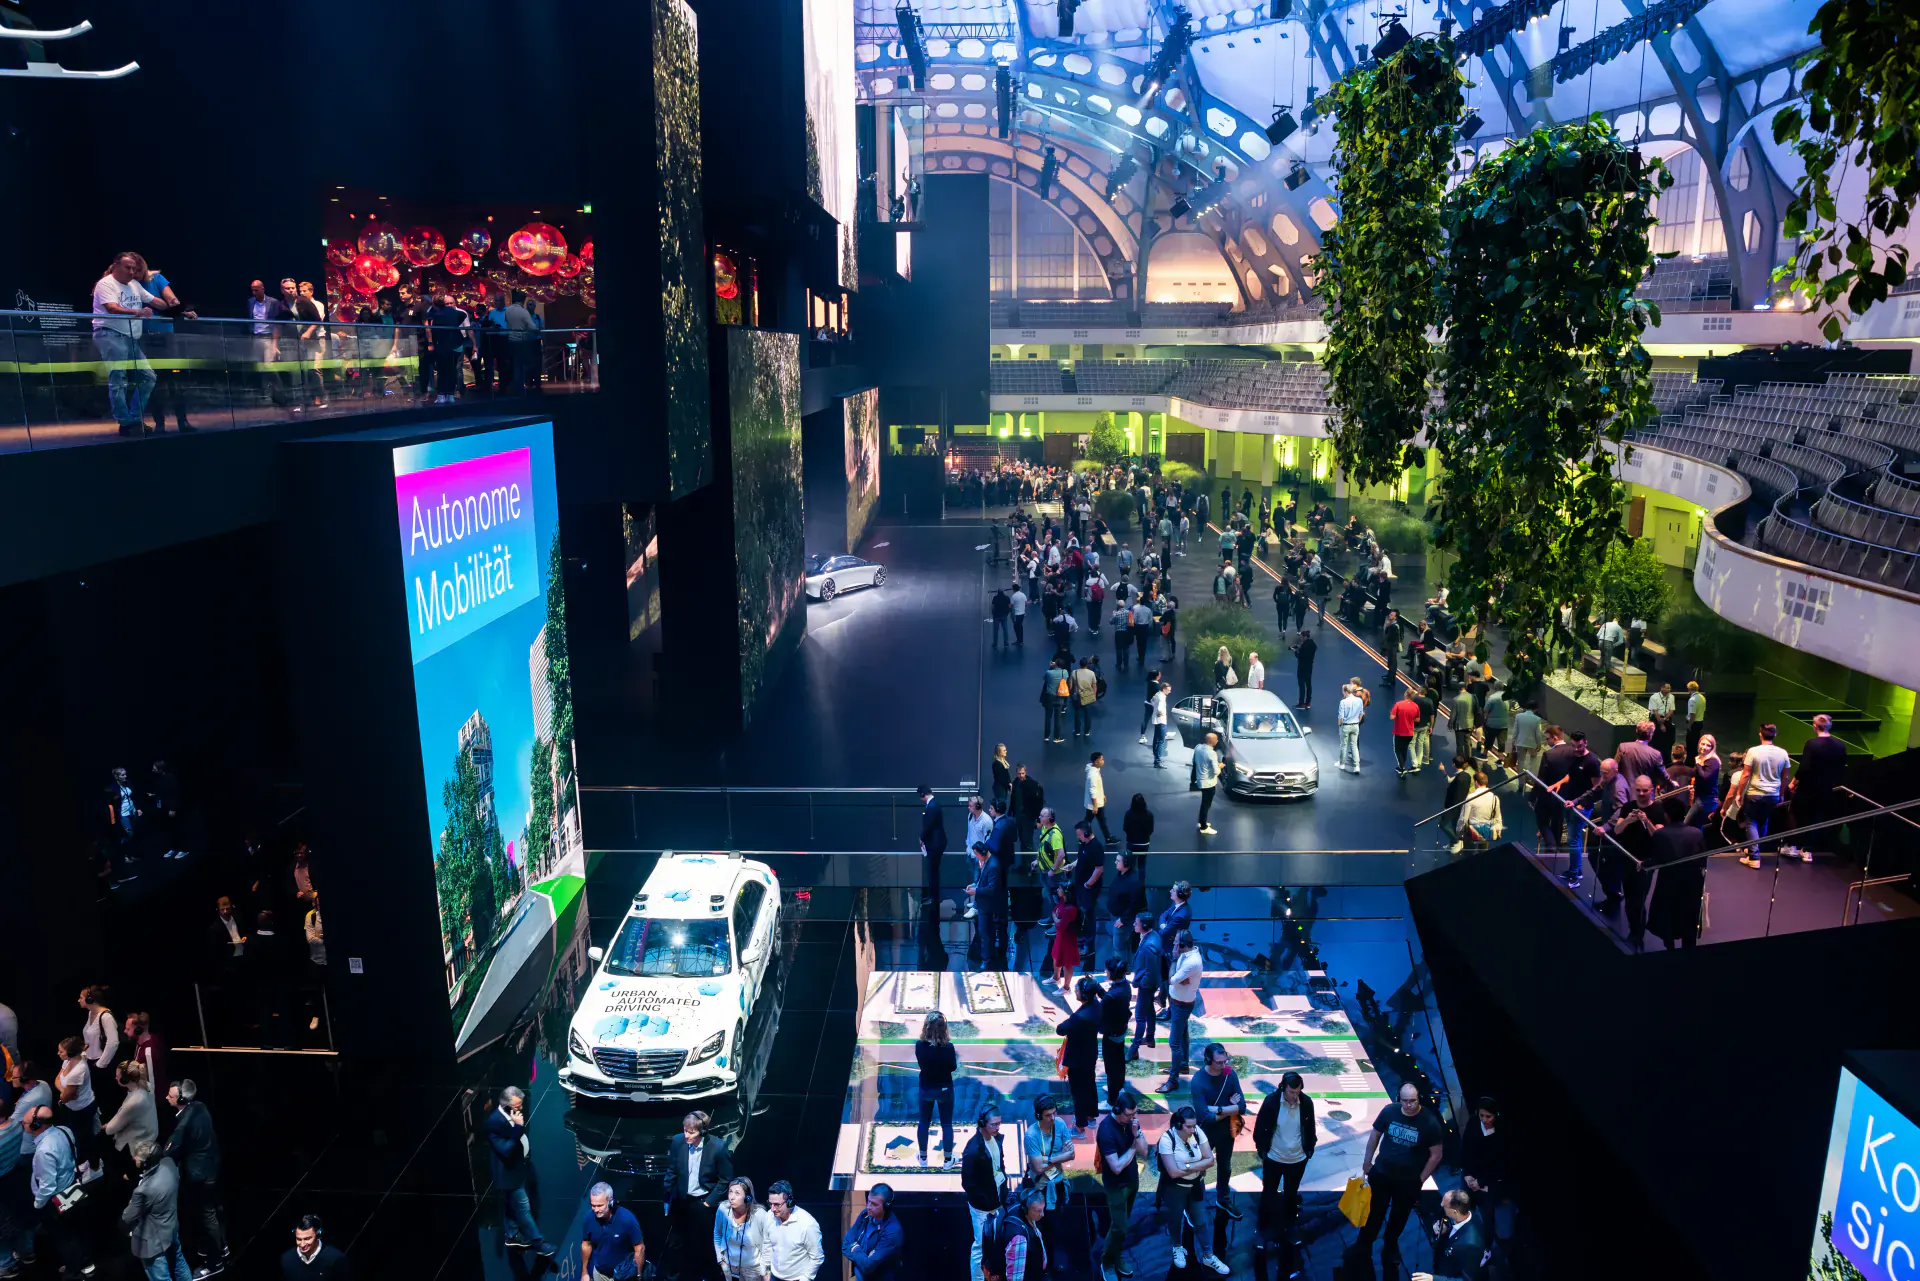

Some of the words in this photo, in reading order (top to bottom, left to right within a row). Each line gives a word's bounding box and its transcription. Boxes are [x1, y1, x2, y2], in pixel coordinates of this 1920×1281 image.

[411, 483, 521, 556] Autonome
[415, 544, 514, 634] Mobilität
[611, 990, 657, 998] URBAN
[617, 997, 701, 1006] AUTOMATED
[604, 1004, 662, 1012] DRIVING
